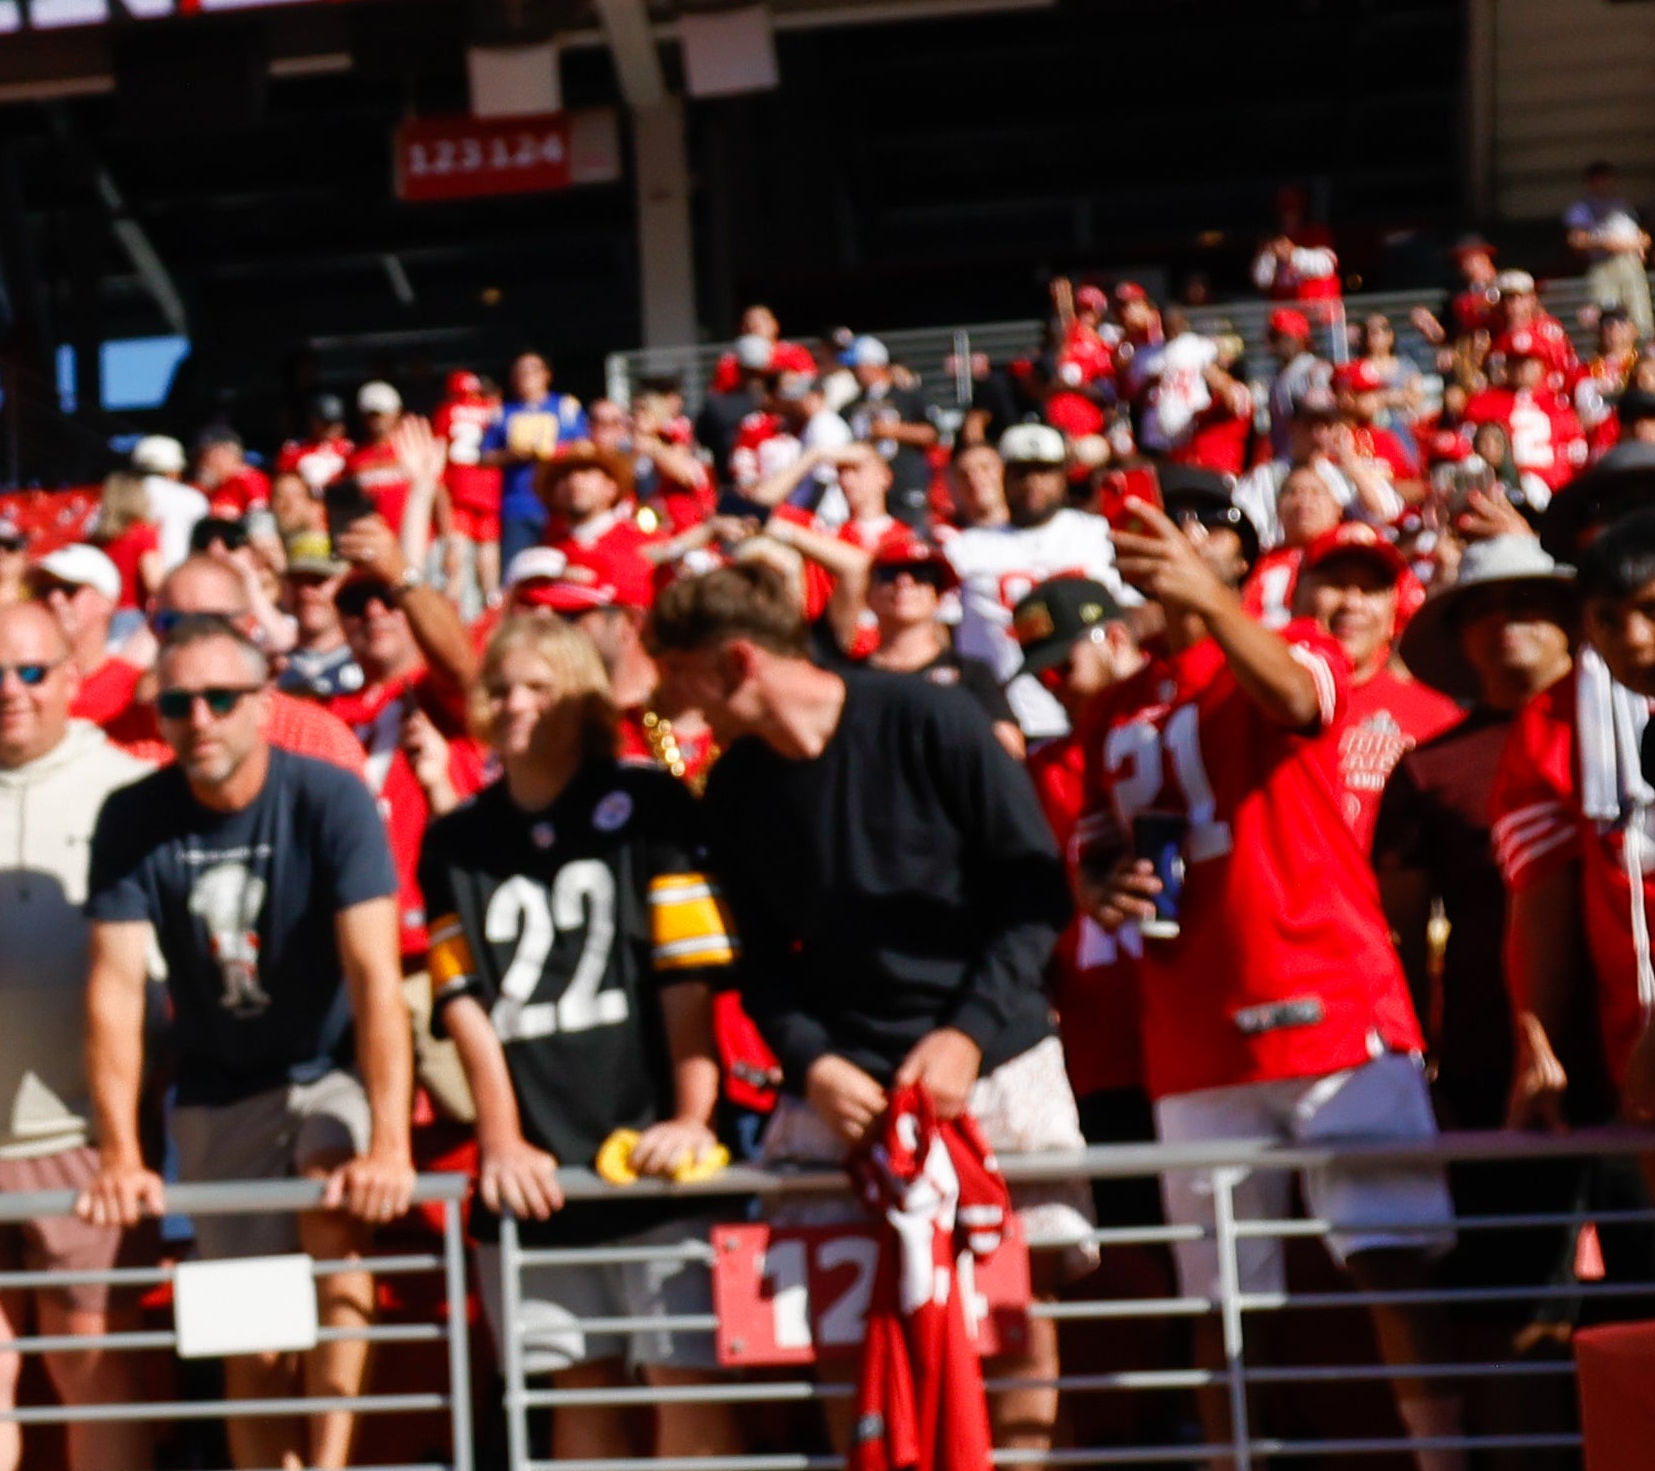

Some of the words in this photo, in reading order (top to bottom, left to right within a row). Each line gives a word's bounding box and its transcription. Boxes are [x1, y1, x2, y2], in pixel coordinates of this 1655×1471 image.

[407, 140, 482, 176] 123
[491, 132, 564, 170] 124
[484, 857, 630, 1042] 22
